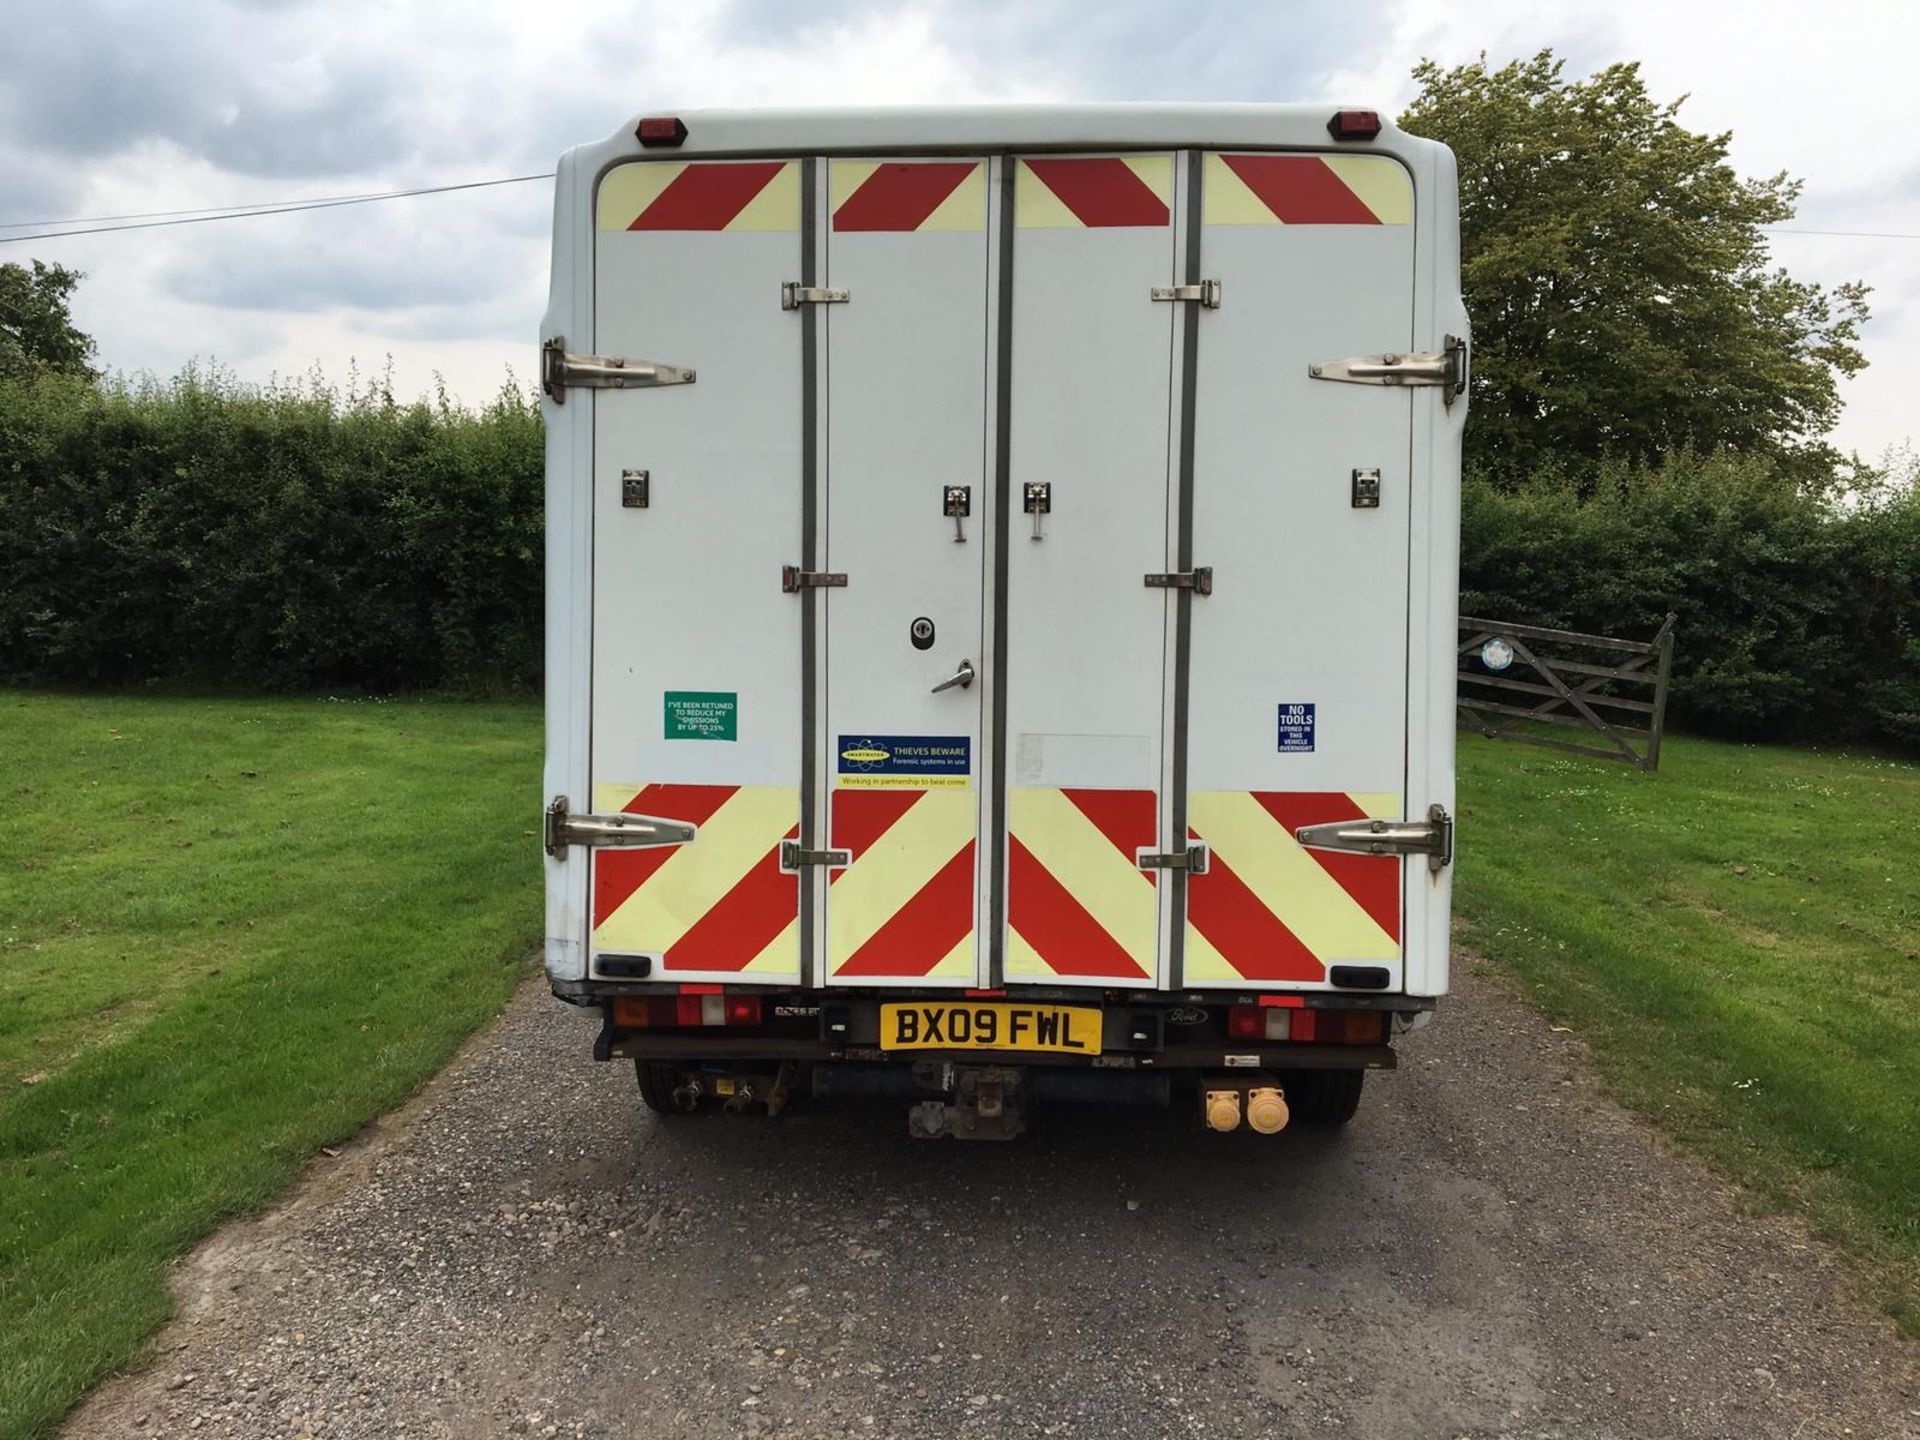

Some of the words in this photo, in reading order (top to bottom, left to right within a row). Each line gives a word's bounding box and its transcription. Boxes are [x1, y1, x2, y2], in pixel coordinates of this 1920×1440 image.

[667, 701, 681, 709] I'VE
[683, 701, 700, 709] BEEN
[701, 702, 734, 710] RETUNED
[1289, 705, 1305, 715] NO
[686, 709, 714, 717] REDUCE
[681, 716, 720, 724] EMISSIONS
[1280, 714, 1313, 725] TOOLS
[698, 724, 709, 732] TO
[894, 746, 929, 756] THIEVES
[930, 747, 966, 756] BEWARE
[893, 757, 919, 765] Forensic
[921, 758, 946, 767] systems
[947, 758, 954, 766] in
[841, 777, 872, 786] Working
[880, 778, 920, 787] partnership
[921, 778, 929, 786] to
[929, 778, 946, 786] beat
[946, 778, 966, 786] crime
[1171, 1008, 1200, 1022] Ford
[896, 1008, 998, 1043] BX09
[1009, 1010, 1085, 1049] FWL
